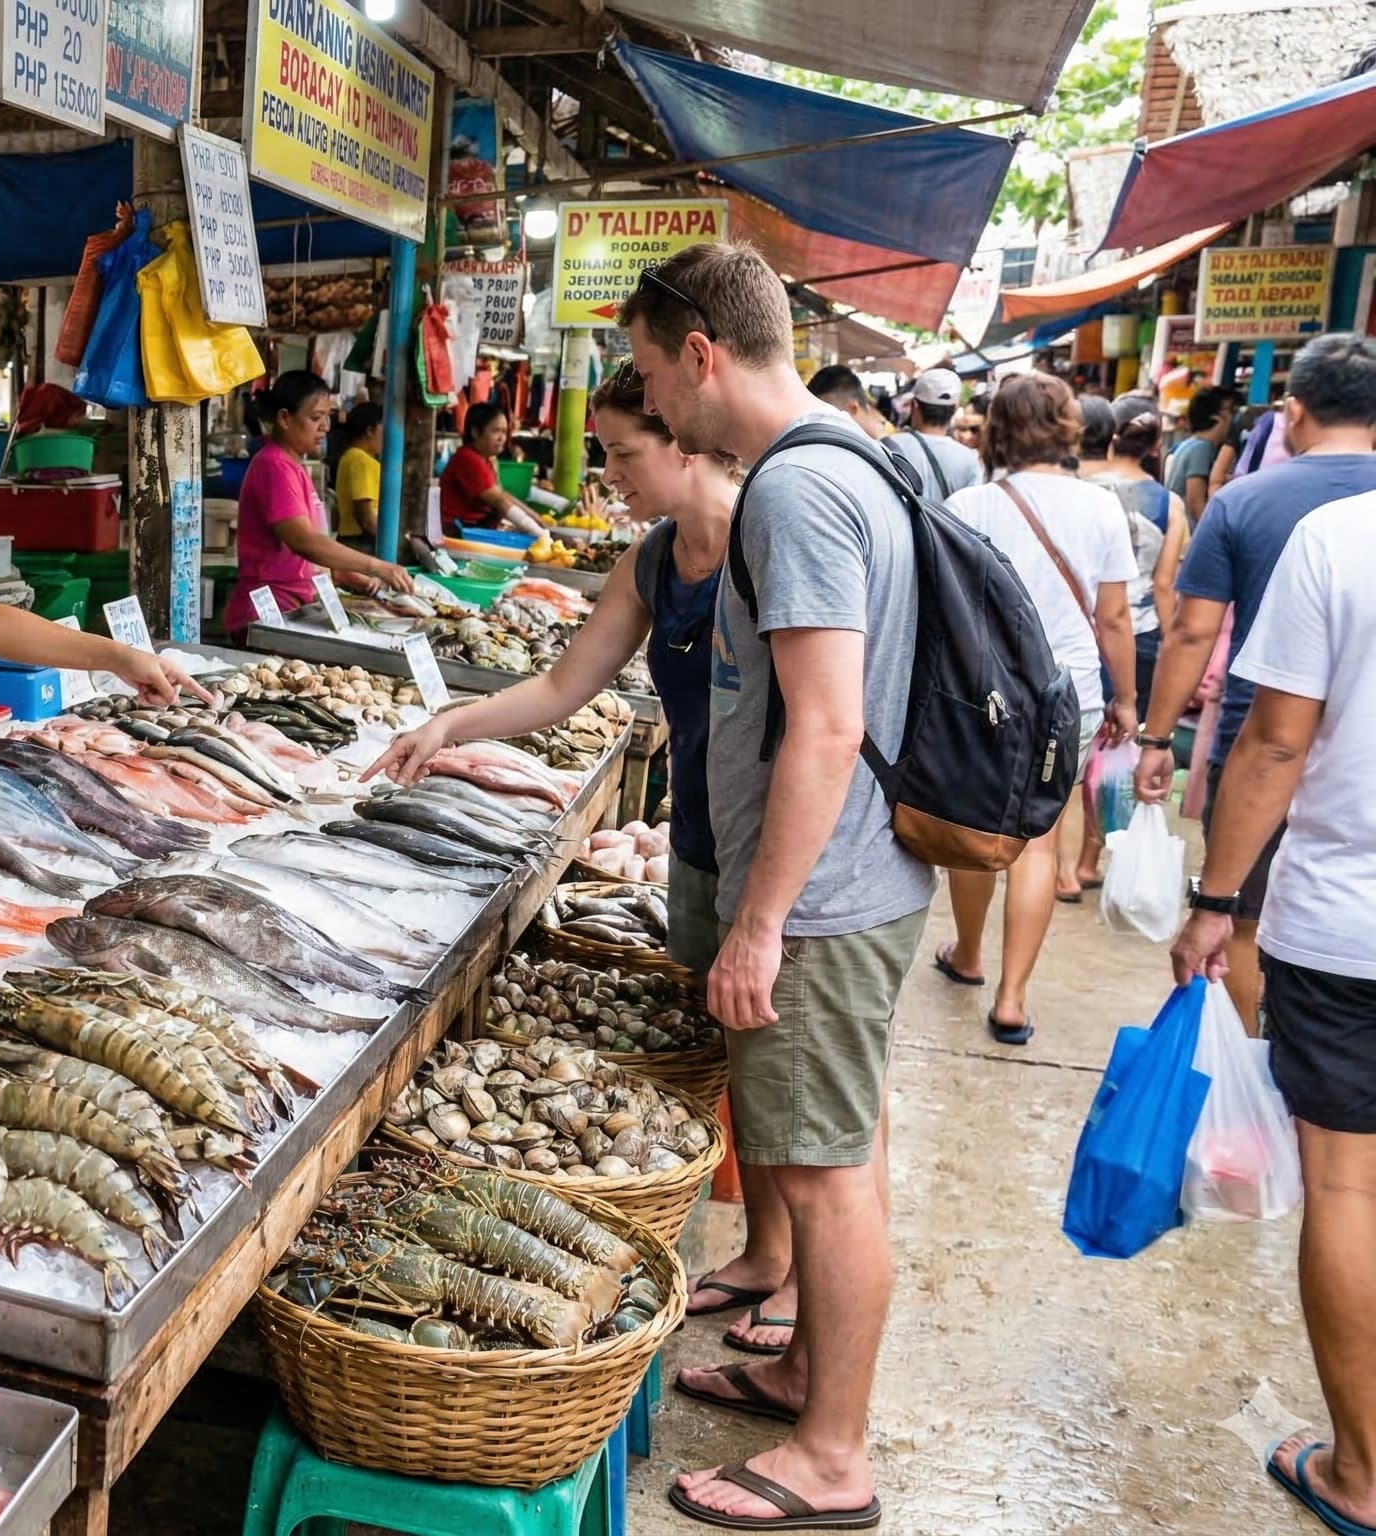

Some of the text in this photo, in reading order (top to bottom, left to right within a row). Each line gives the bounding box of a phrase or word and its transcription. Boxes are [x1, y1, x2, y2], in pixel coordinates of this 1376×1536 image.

[15, 0, 48, 49] PHP
[62, 25, 82, 65] 20
[14, 51, 47, 98] PHP
[279, 41, 343, 117] BORACAY
[567, 209, 717, 237] D' TALIPAPA
